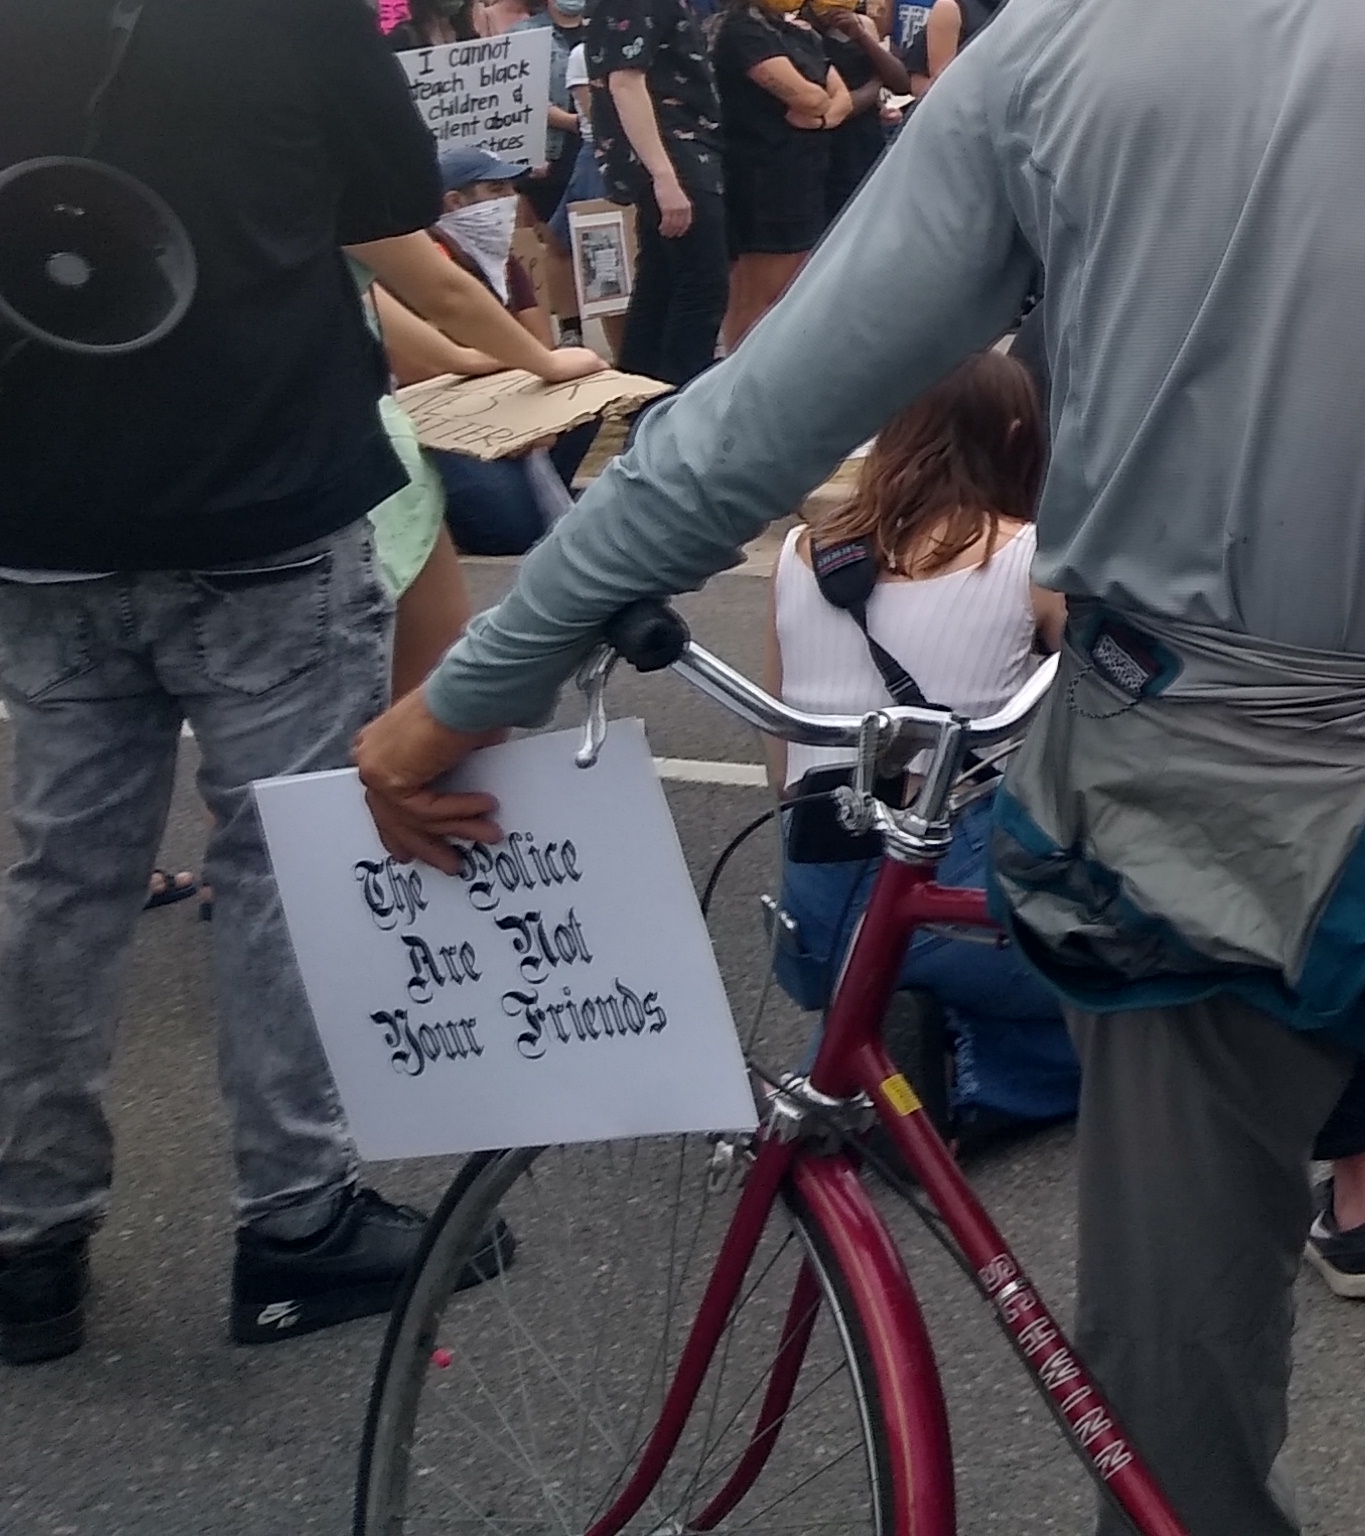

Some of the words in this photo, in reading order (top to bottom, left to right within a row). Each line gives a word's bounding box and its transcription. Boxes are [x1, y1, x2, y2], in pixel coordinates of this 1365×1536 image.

[409, 72, 464, 101] teach
[480, 59, 530, 88] black
[418, 49, 435, 76] I
[449, 36, 512, 68] cannot
[428, 93, 499, 121] children
[512, 84, 524, 105] &
[484, 105, 533, 131] about
[354, 850, 430, 931] The
[452, 831, 584, 911] Police
[400, 934, 483, 1004] Are
[494, 906, 594, 984] Not
[369, 1008, 486, 1077] Your
[501, 976, 668, 1060] Friends
[977, 1252, 1134, 1482] SCHWINN
